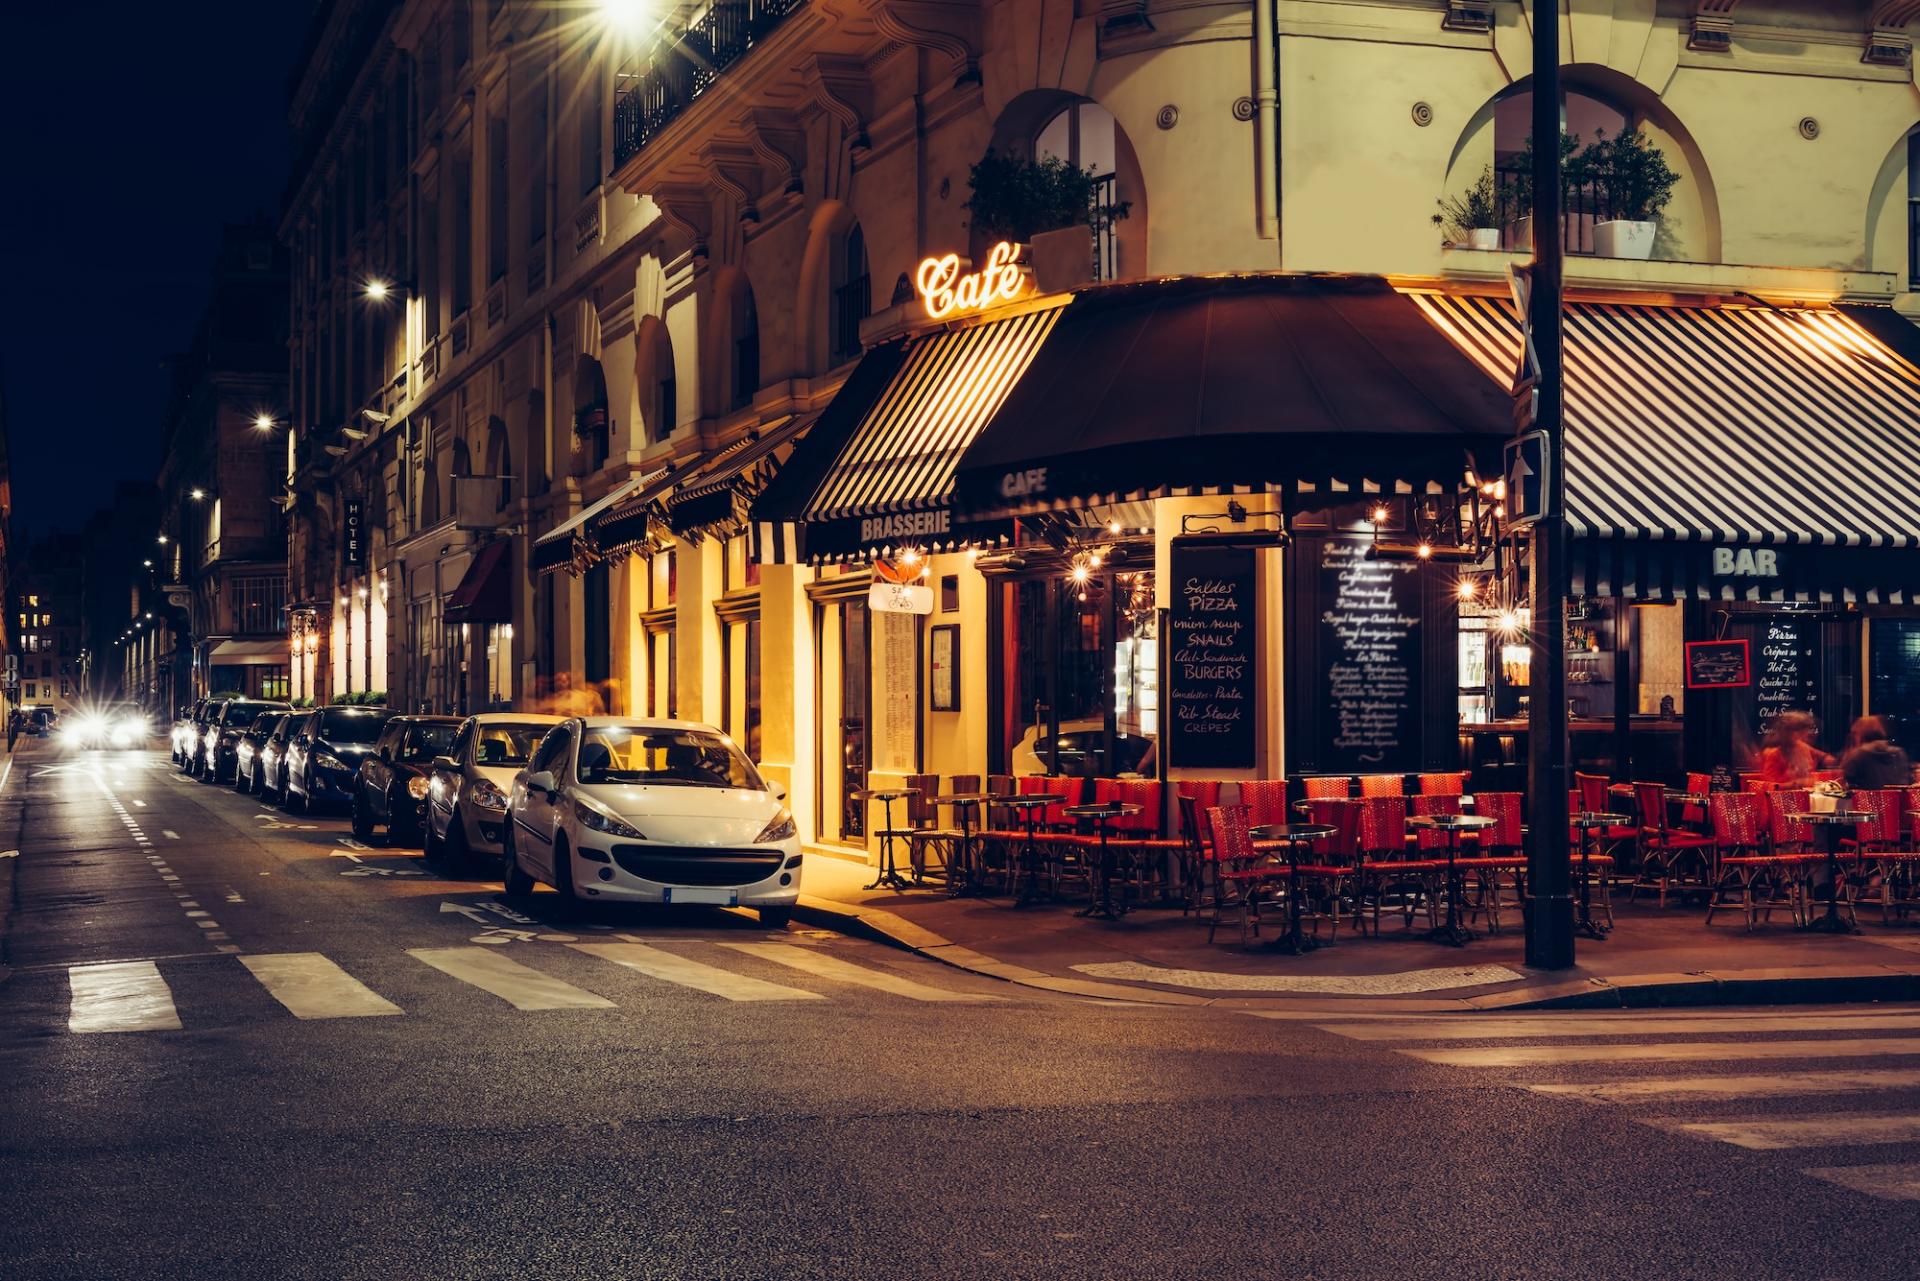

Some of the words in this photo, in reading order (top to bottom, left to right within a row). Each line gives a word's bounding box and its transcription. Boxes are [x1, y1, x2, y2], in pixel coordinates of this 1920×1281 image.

[917, 241, 1025, 318] Café
[1000, 467, 1048, 498] CAFE
[348, 504, 359, 561] HOTEL
[860, 509, 951, 543] BRASSERIE
[1712, 547, 1779, 577] BAR
[1187, 633, 1234, 646] SNAILS
[1184, 664, 1243, 680] BURGERS
